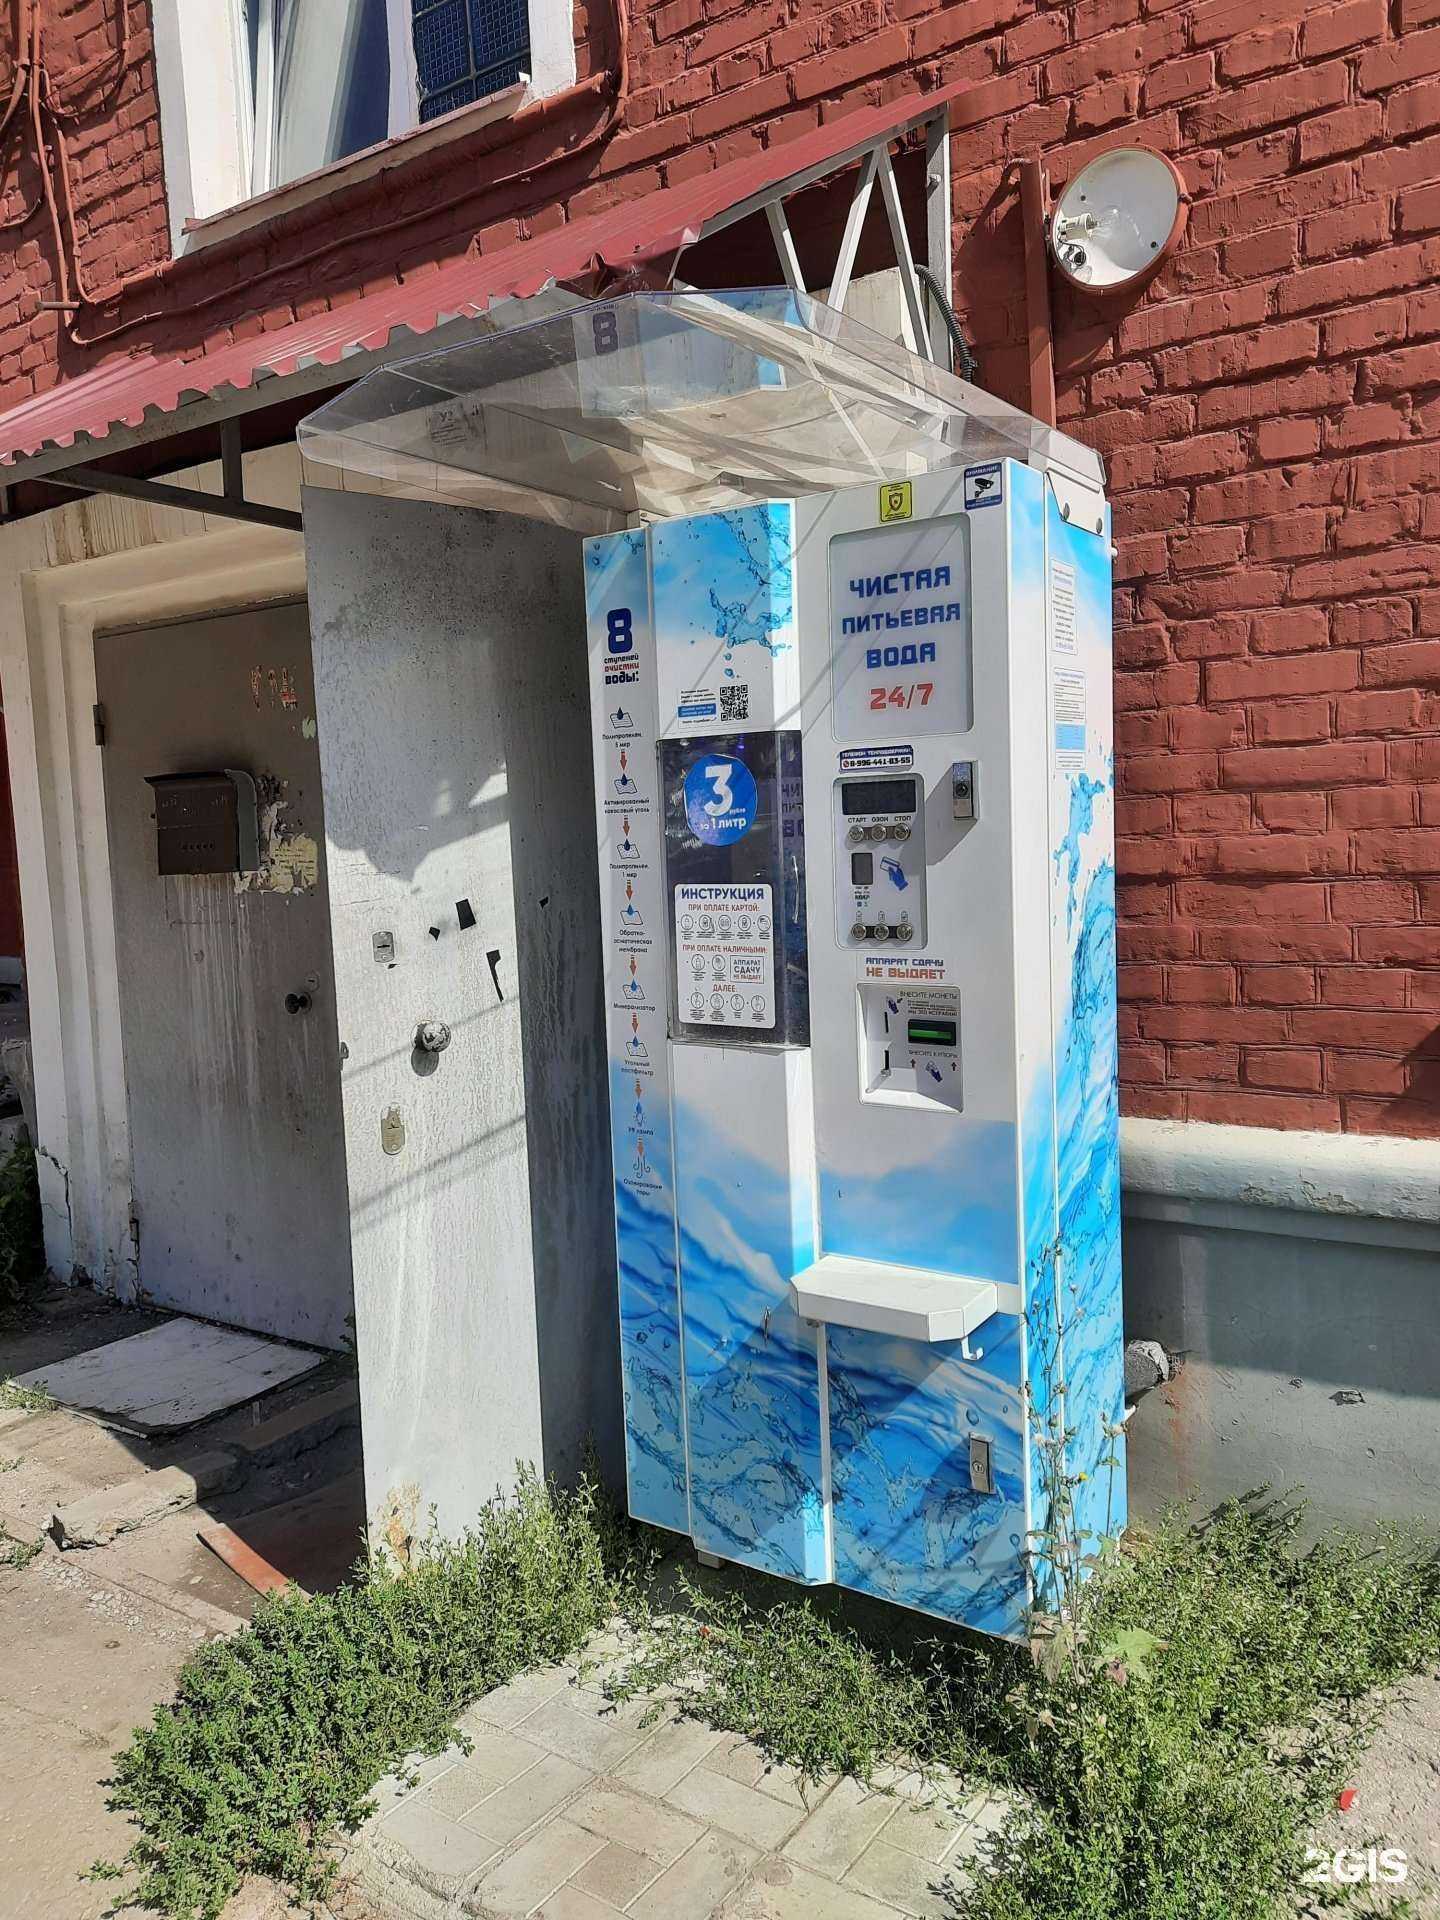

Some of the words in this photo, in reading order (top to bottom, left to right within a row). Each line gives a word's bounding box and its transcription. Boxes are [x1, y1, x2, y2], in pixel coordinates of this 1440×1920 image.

[849, 566, 951, 598] ЧИСТАЯ
[842, 602, 961, 635] ПИТЬЕВАЯ
[607, 608, 633, 654] 8
[866, 641, 936, 669] ВОДА
[870, 683, 934, 710] 24/7
[703, 763, 733, 817] 3
[711, 817, 716, 830] 1
[718, 817, 747, 830] литр
[681, 888, 764, 900] ИНСТРУКЦИЯ
[731, 903, 760, 912] КАРТОЙ:
[696, 945, 721, 953] ОПЛАТЕ
[865, 957, 909, 966] АППАРАТ
[912, 957, 944, 967] СДАЧУ
[733, 966, 761, 974] СДАЧУ
[866, 967, 884, 977] НЕ
[888, 967, 946, 979] ВЫДАЕТ
